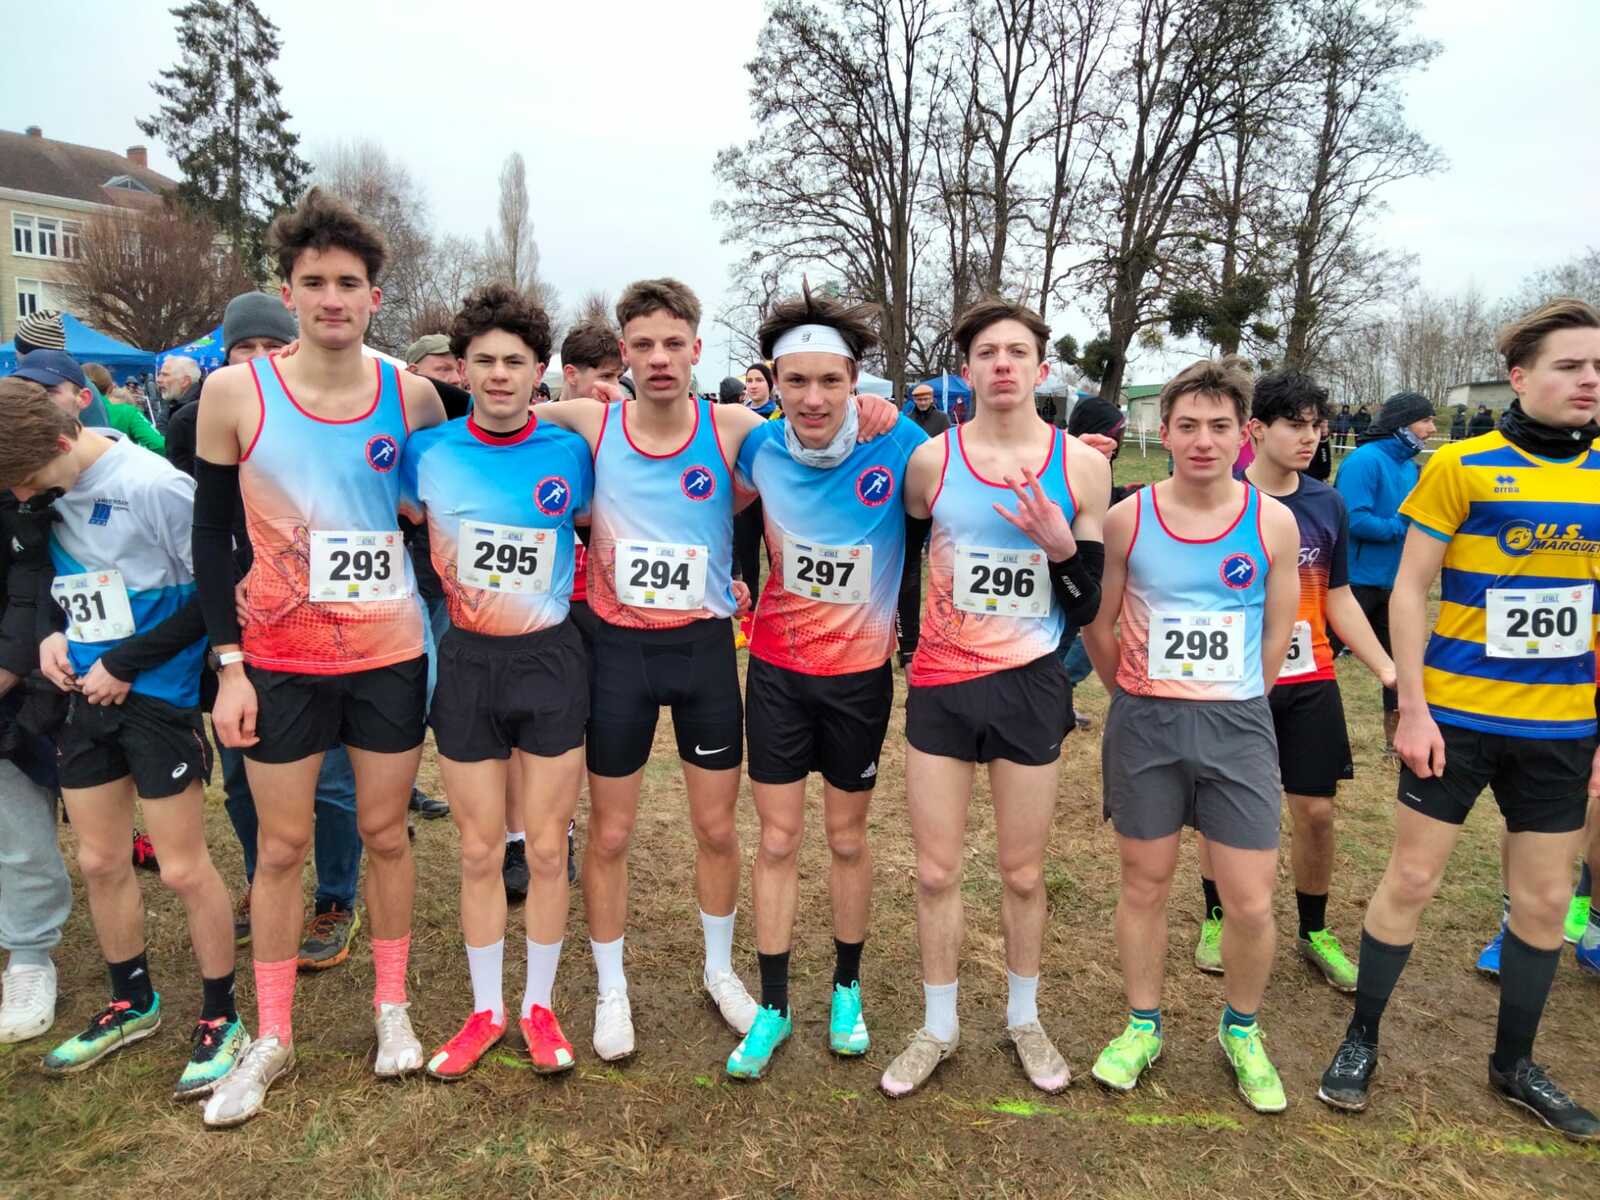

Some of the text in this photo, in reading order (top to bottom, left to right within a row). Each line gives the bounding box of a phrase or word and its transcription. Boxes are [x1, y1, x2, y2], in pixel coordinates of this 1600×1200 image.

[1530, 539, 1600, 553] MARQUE
[1535, 523, 1585, 540] U.S.
[329, 550, 391, 581] 293
[473, 541, 539, 576] 295
[629, 558, 690, 591] 294
[797, 555, 855, 587] 297
[969, 565, 1035, 598] 296
[1506, 606, 1578, 638] 260
[1164, 630, 1229, 661] 298
